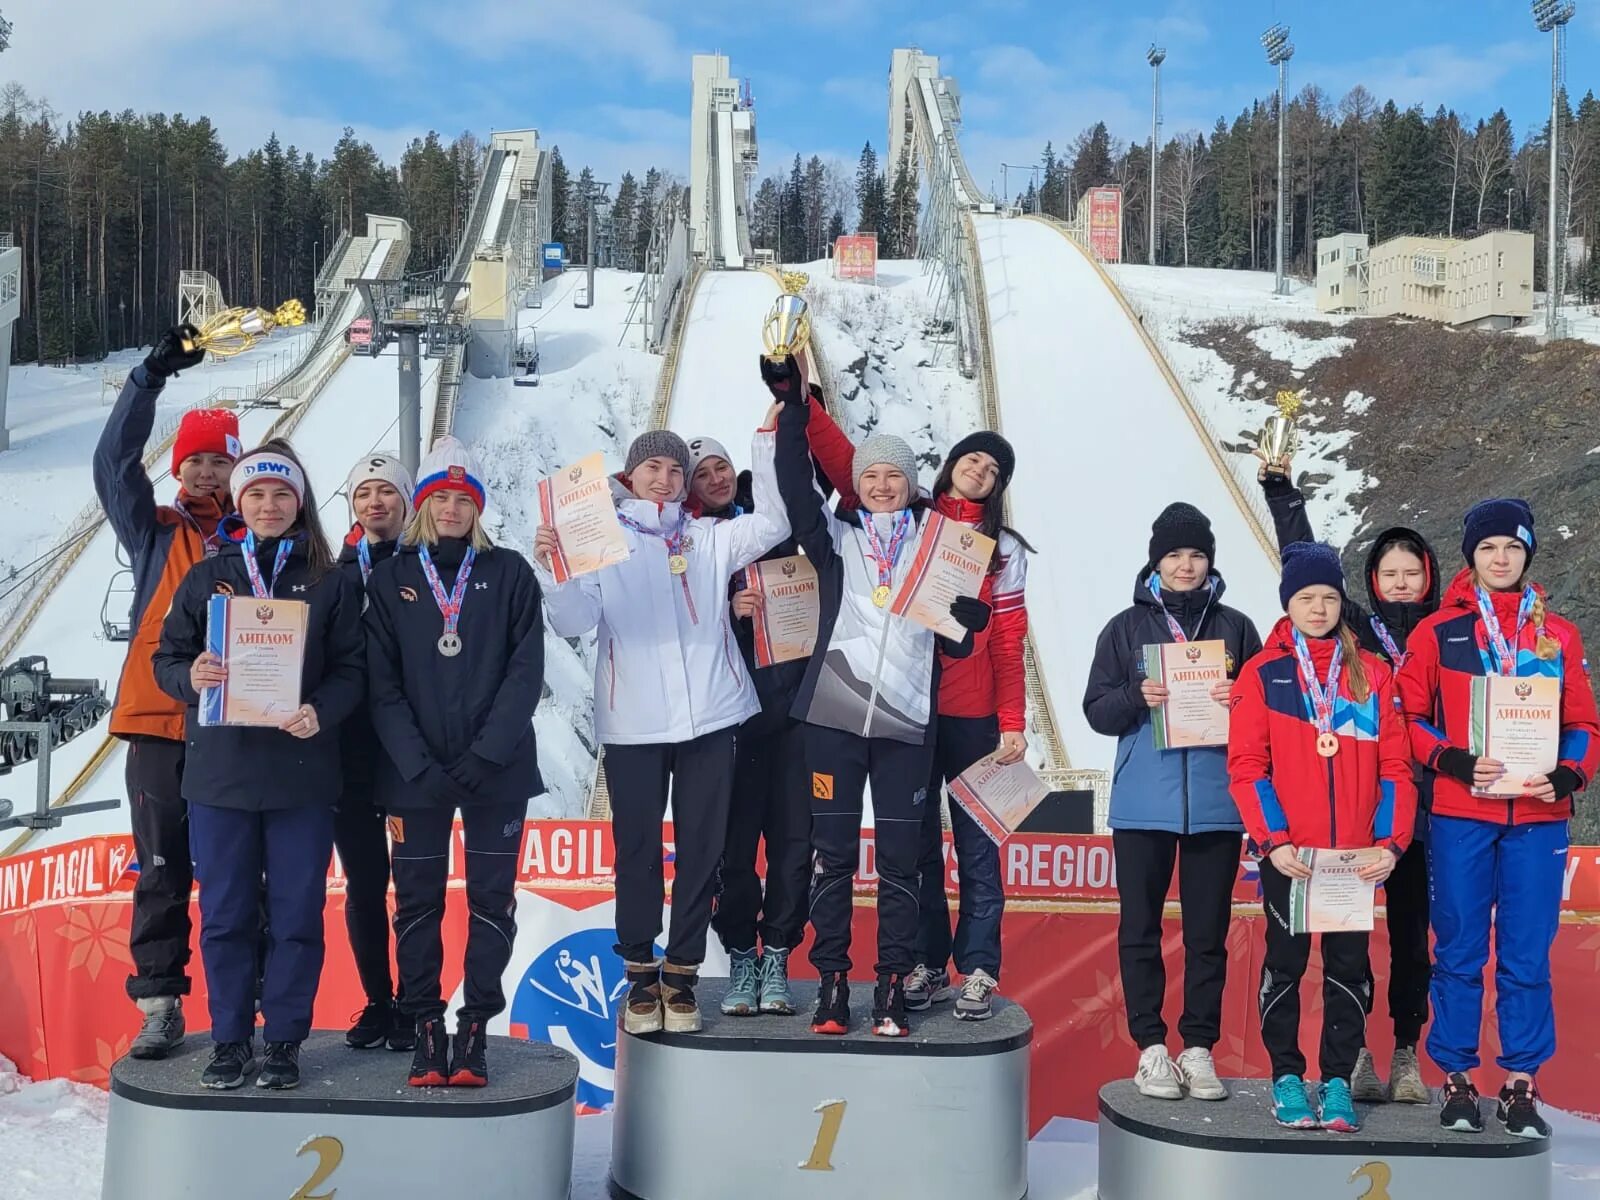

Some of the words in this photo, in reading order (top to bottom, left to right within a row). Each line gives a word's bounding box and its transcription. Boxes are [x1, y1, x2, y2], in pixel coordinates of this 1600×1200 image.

[257, 462, 291, 476] BWT
[558, 481, 602, 508] ДИПЛОМ
[939, 550, 981, 576] ДИПЛОМ
[770, 582, 815, 600] ДИПЛОМ
[236, 633, 294, 645] ДИПЛОМ
[1172, 670, 1220, 683] ДИПЛОМ
[1496, 708, 1552, 720] ДИПЛОМ
[0, 860, 34, 909] NY
[41, 846, 104, 900] TAGIL
[798, 1099, 847, 1171] 1
[288, 1135, 344, 1200] 2
